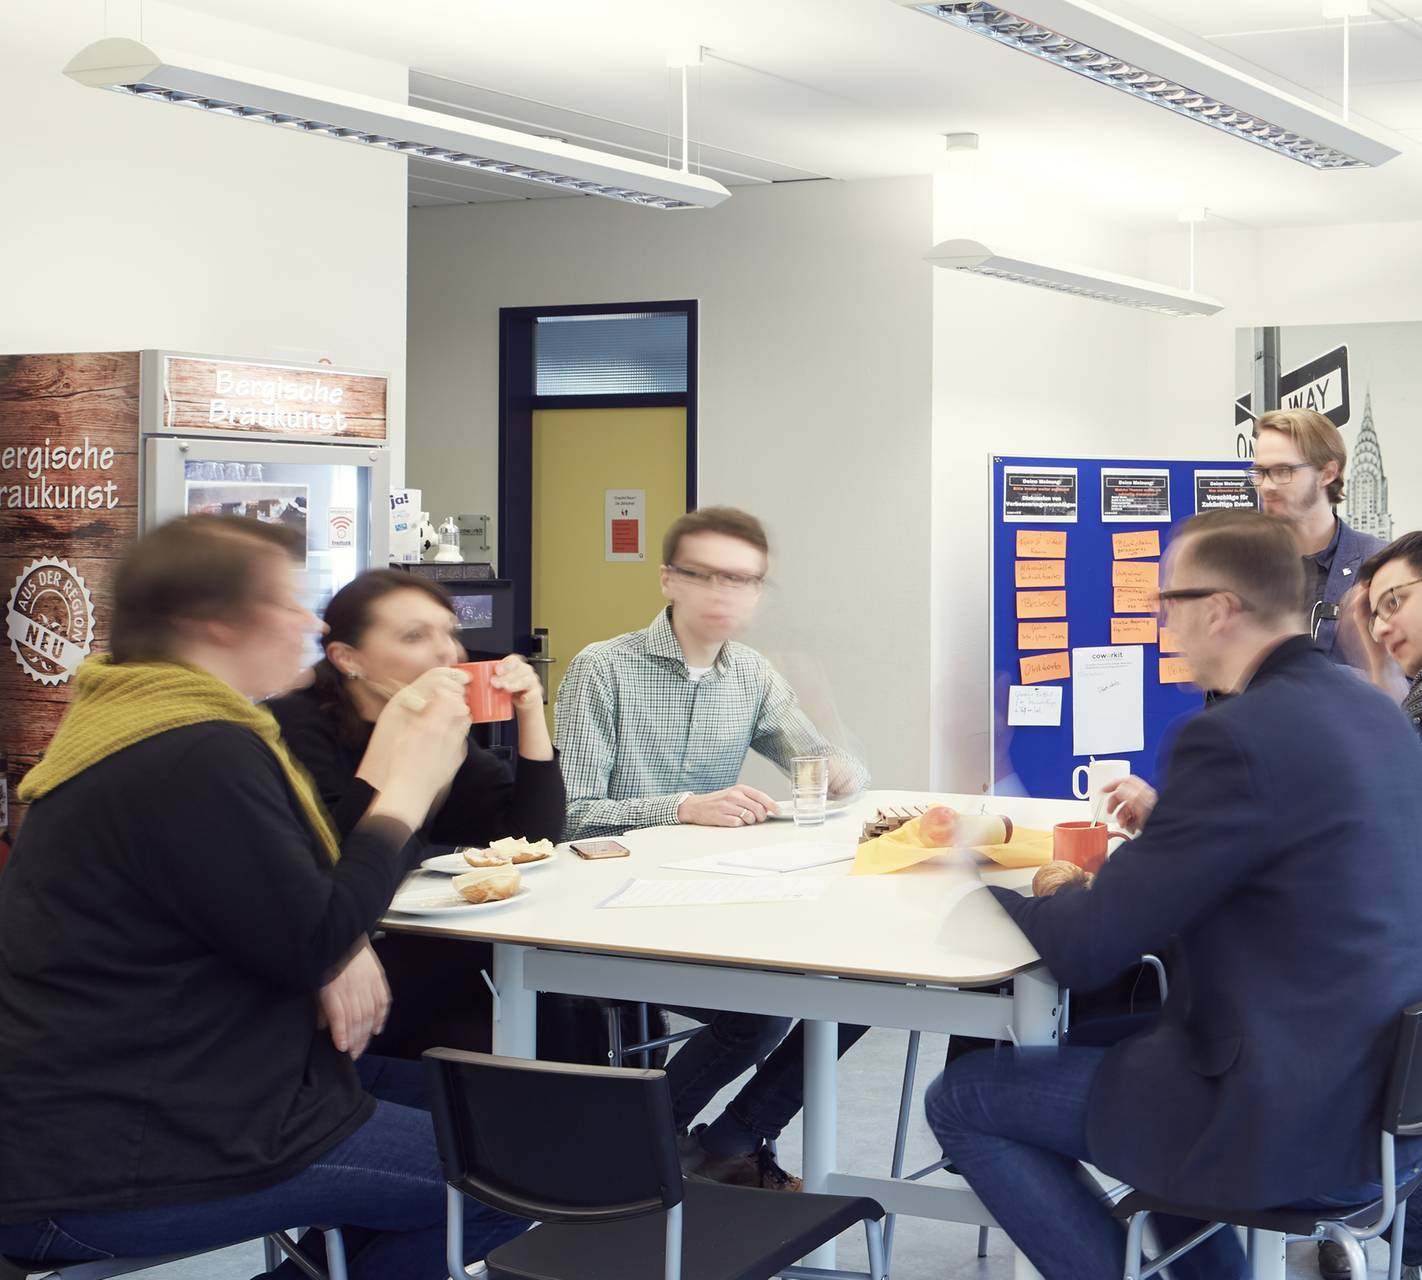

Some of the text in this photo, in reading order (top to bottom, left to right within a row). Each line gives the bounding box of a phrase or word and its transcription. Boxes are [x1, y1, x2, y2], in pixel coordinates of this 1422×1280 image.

[216, 370, 343, 404] Bergische
[1288, 378, 1330, 411] WAY
[209, 399, 348, 431] Braukunst
[0, 436, 114, 478] ergische
[0, 476, 119, 509] raukunst
[389, 493, 409, 510] ja!
[18, 570, 85, 642] AUS DER REGION
[25, 622, 64, 659] NEU
[1091, 651, 1124, 659] cowrkit
